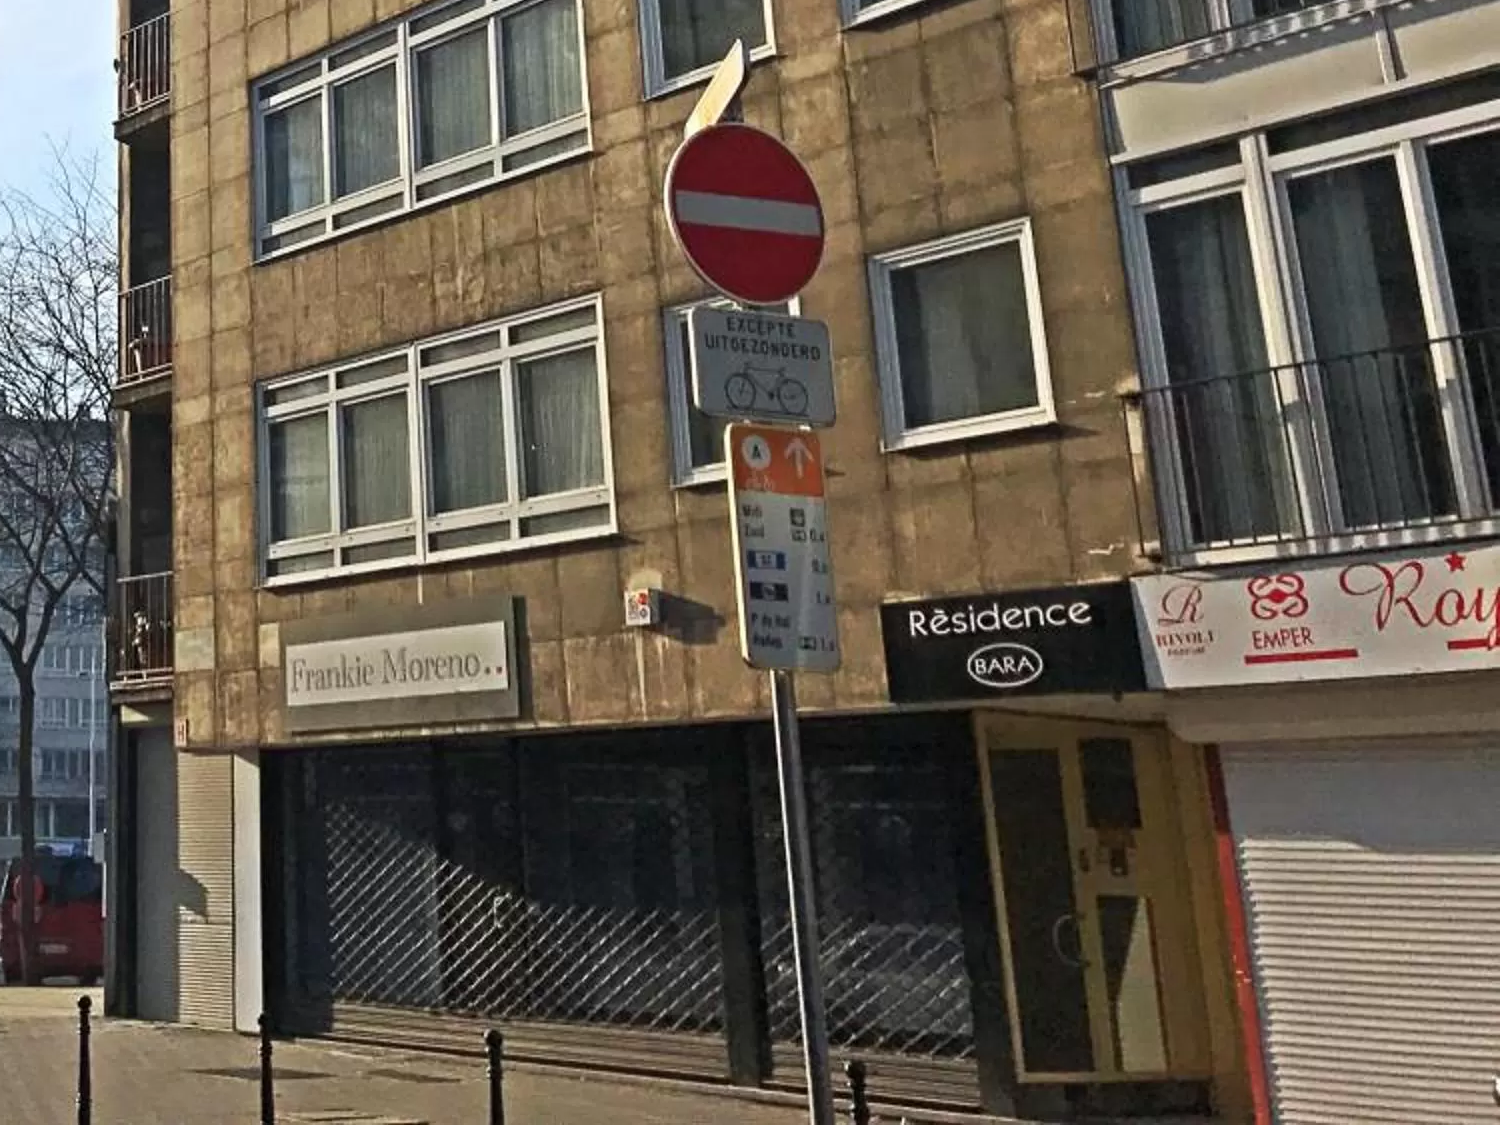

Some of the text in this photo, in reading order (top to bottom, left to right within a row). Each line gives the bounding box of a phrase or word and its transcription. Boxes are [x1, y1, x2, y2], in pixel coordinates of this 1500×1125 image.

[752, 444, 764, 460] A
[1252, 627, 1314, 650] EMPER
[291, 652, 374, 693] Frankie
[974, 656, 1035, 675] BARA
